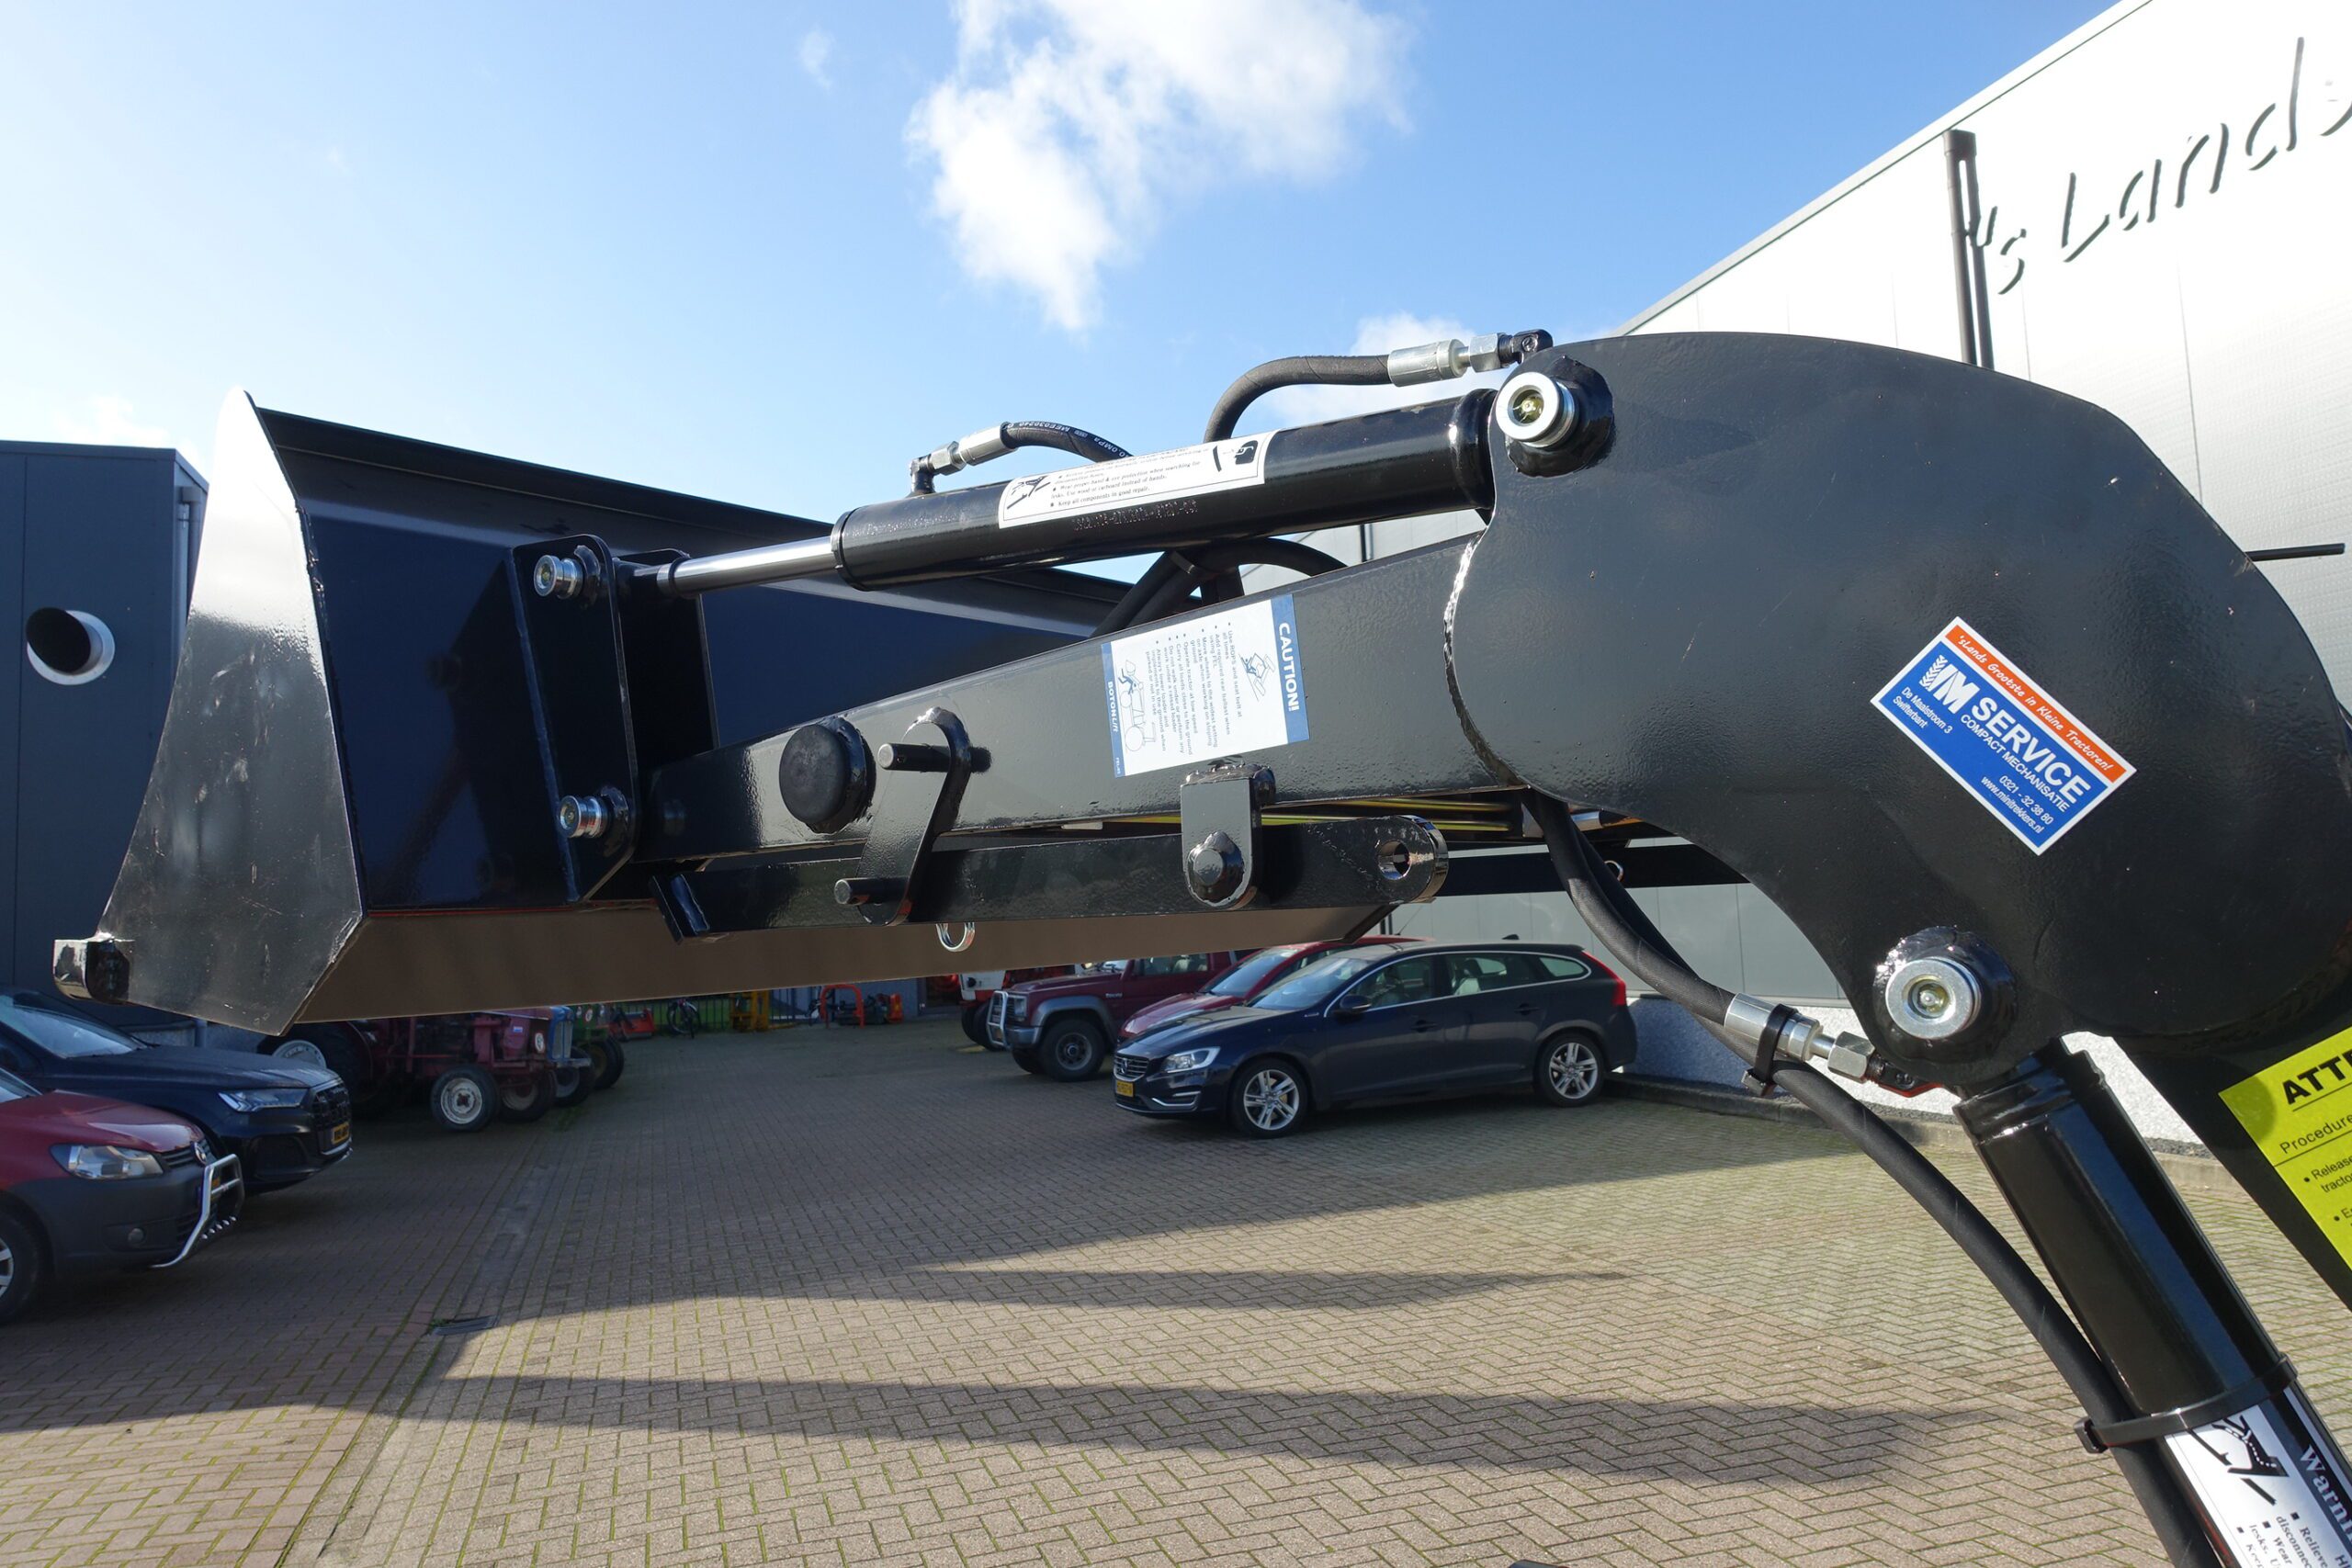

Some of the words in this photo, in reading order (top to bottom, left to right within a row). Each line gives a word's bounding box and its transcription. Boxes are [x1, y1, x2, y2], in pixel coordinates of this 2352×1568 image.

[1093, 437, 1128, 458] 0.0MPa
[1278, 622, 1299, 712] CAUTION!
[1894, 696, 1928, 728] Swifterbant
[1902, 687, 1913, 698] De
[1987, 663, 2025, 696] Grootste
[2025, 696, 2036, 705] in
[2037, 706, 2064, 730] Kleine
[2066, 730, 2113, 770] Tractoren!
[1961, 715, 2006, 753] COMPACT
[2002, 751, 2070, 812] MECHANISATIE
[1971, 695, 2092, 805] SERVICE
[1982, 777, 2044, 833] www.minitrekkers.nl
[1999, 776, 2018, 793] 0321
[2021, 795, 2034, 807] 32
[2031, 805, 2043, 818] 38
[2041, 813, 2053, 824] 80
[2321, 1172, 2352, 1193] tracto
[2273, 1537, 2292, 1564] Wear
